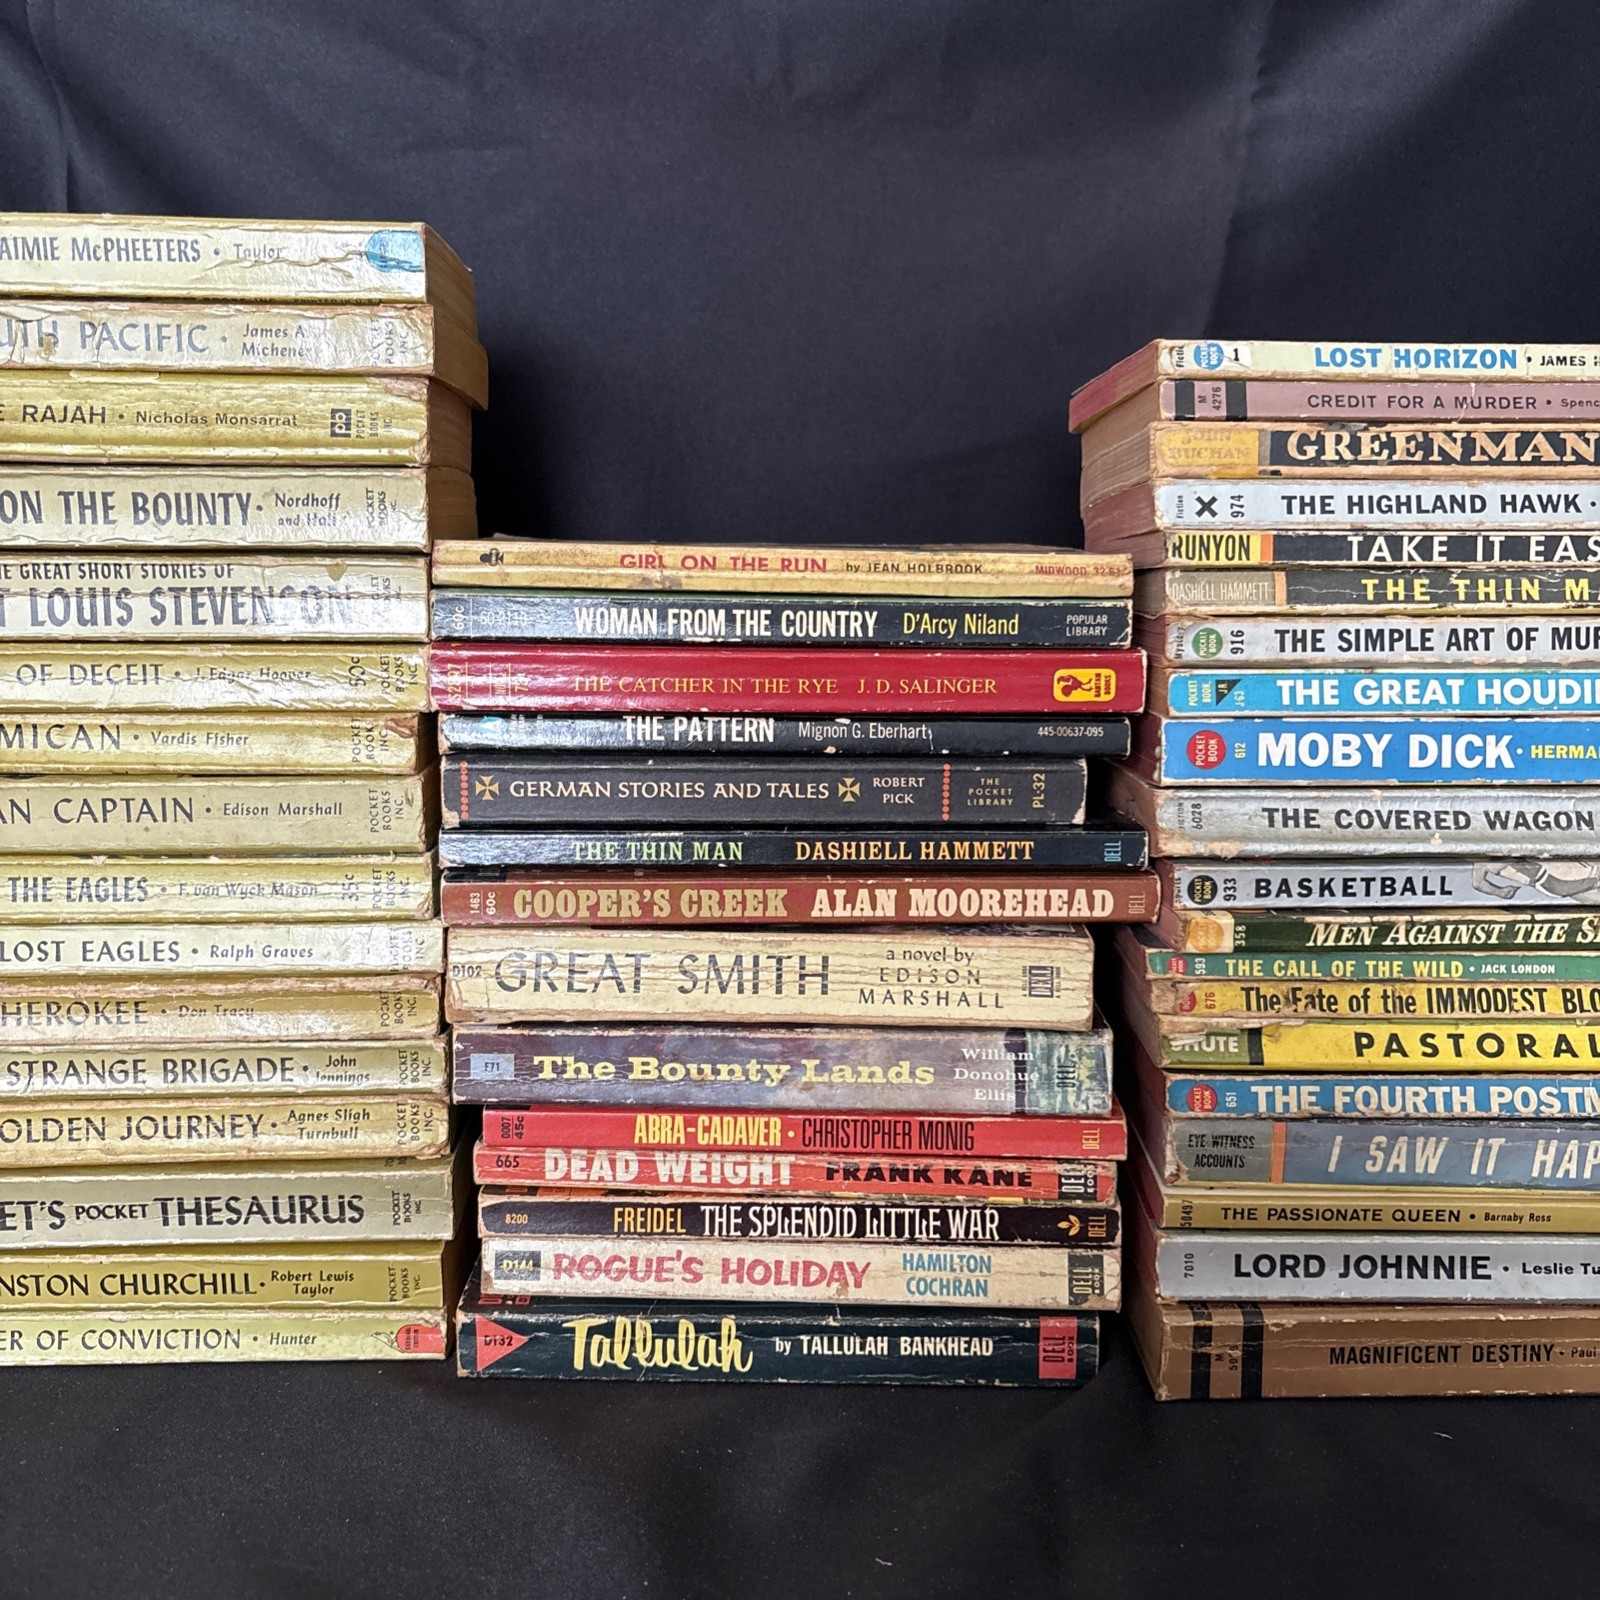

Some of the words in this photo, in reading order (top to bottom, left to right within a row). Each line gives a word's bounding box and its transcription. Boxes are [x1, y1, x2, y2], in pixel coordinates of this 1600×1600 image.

[71, 236, 201, 263] McPHEETERS
[80, 321, 207, 353] PACIFIC
[1315, 347, 1382, 368] LOST
[1394, 349, 1517, 369] HORIZON
[1540, 355, 1586, 367] JAMES
[1308, 394, 1376, 409] CREDIT
[1387, 395, 1423, 409] FOR
[1454, 396, 1537, 410] MURDER
[22, 405, 107, 424] RAJAH
[135, 411, 208, 426] Nicholas
[216, 412, 298, 427] Monsarrat
[58, 491, 116, 525] THE
[133, 492, 251, 526] BOUNTY
[1281, 495, 1335, 515] THE
[1347, 495, 1486, 514] HIGHLAND
[1500, 494, 1581, 513] HAWK
[1347, 536, 1448, 561] TAKE
[1477, 536, 1510, 561] IT
[20, 563, 72, 581] GREAT
[78, 563, 132, 580] SHORT
[619, 554, 667, 569] GIRL
[681, 556, 717, 570] ON
[730, 557, 768, 571] THE
[781, 558, 827, 573] RUN
[846, 562, 860, 574] by
[867, 562, 900, 574] JEAN
[907, 563, 983, 574] HOLBROOK
[1362, 579, 1431, 601] THE
[1455, 579, 1540, 601] THIN
[30, 587, 133, 627] LOUIS
[574, 608, 658, 636] WOMAN
[669, 608, 726, 636] FROM
[733, 609, 771, 637] THE
[782, 610, 878, 638] COUNTRY
[904, 612, 957, 639] D'Arcy
[964, 613, 1019, 635] Niland
[1066, 614, 1108, 626] POPULAR
[1066, 625, 1107, 637] LIBRARY
[1275, 629, 1325, 653] THE
[1337, 628, 1434, 652] SIMPLE
[1446, 628, 1495, 651] ART
[1506, 627, 1539, 651] OF
[70, 664, 164, 686] DECEIT
[618, 678, 714, 693] CATCHER
[722, 679, 744, 693] IN
[751, 679, 790, 693] THE
[798, 679, 838, 694] RYE
[899, 679, 997, 694] SALINGER
[1276, 679, 1340, 706] THE
[1354, 679, 1465, 705] GREAT
[151, 731, 198, 746] Vardis
[206, 731, 249, 746] Fisher
[674, 717, 774, 743] PATTERN
[798, 722, 847, 741] Mignon
[1037, 726, 1104, 737] 445-00637-095
[1258, 732, 1393, 768] MOBY
[1409, 735, 1516, 769] DICK
[510, 781, 611, 798] GERMAN
[618, 782, 705, 798] STORIES
[713, 783, 761, 798] AND
[768, 783, 829, 799] TALES
[873, 777, 925, 788] ROBERT
[969, 788, 1012, 796] POCKET
[981, 778, 999, 786] THE
[883, 793, 914, 804] PICK
[967, 798, 1014, 806] LIBRARY
[54, 797, 194, 823] CAPTAIN
[223, 803, 269, 816] Edison
[278, 802, 342, 816] Marshall
[370, 788, 379, 833] POCKET
[1261, 808, 1320, 829] THE
[1334, 809, 1470, 830] COVERED
[1483, 810, 1594, 830] WAGON
[626, 842, 683, 861] THIN
[693, 842, 743, 861] MAN
[796, 842, 912, 861] DASHIELL
[920, 842, 1035, 861] HAMMETT
[67, 877, 149, 902] EAGLES
[1254, 876, 1453, 898] BASKETBALL
[681, 889, 789, 918] CREEK
[811, 889, 897, 917] ALAN
[909, 889, 1115, 918] MOOREHEAD
[82, 941, 180, 962] EAGLES
[210, 945, 254, 959] Ralph
[263, 946, 314, 958] Graves
[903, 947, 946, 961] novel
[495, 952, 651, 993] GREAT
[677, 954, 829, 995] SMITH
[880, 967, 981, 985] EDISON
[1226, 960, 1263, 976] THE
[1273, 960, 1321, 976] CALL
[1332, 961, 1355, 976] OF
[1365, 961, 1401, 976] THE
[1411, 961, 1463, 977] WILD
[1481, 964, 1507, 974] JACK
[1512, 964, 1554, 974] LONDON
[858, 988, 1004, 1009] MARSHALL
[1426, 989, 1547, 1013] IMMODEST
[6, 1060, 147, 1084] STRANGE
[162, 1057, 294, 1084] BRIGADE
[325, 1055, 356, 1068] John
[533, 1056, 616, 1081] The
[628, 1056, 791, 1087] Bounty
[801, 1059, 935, 1084] Lands
[1251, 1086, 1320, 1112] THE
[1334, 1086, 1475, 1113] FOURTH
[120, 1114, 265, 1140] JOURNEY
[634, 1115, 782, 1146] ABRA-CADAVER
[802, 1118, 912, 1149] CHRISTOPHER
[919, 1120, 974, 1150] MONIG
[495, 1155, 520, 1168] 665
[545, 1148, 639, 1181] DEAD
[655, 1152, 795, 1186] WEIGHT
[1194, 1155, 1245, 1168] ACCOUNTS
[1366, 1137, 1448, 1174] SAW
[1471, 1139, 1506, 1176] IT
[75, 1204, 148, 1220] POCKET
[152, 1195, 365, 1227] THESAURUS
[505, 1213, 528, 1224] 8200
[1221, 1207, 1258, 1221] THE
[1267, 1207, 1383, 1222] PASSIONATE
[1391, 1208, 1460, 1223] QUEEN
[1484, 1212, 1524, 1225] Barnaby
[1529, 1212, 1551, 1223] Ross
[613, 1207, 686, 1233] FREIDEL
[700, 1206, 743, 1237] THE
[748, 1206, 857, 1237] SPLENDID
[864, 1207, 941, 1239] LITTLE
[948, 1208, 999, 1240] WAR
[553, 1250, 704, 1284] ROGUE'S
[721, 1257, 871, 1289] HOLIDAY
[902, 1253, 991, 1274] HAMILTON
[1184, 1253, 1194, 1278] 7010
[1234, 1254, 1325, 1278] LORD
[1338, 1255, 1492, 1280] JOHNNIE
[1522, 1262, 1574, 1275] Leslie
[100, 1273, 257, 1296] CHURCHILL
[271, 1270, 312, 1283] Robert
[320, 1270, 354, 1283] Lewis
[906, 1276, 988, 1297] COCHRAN
[294, 1283, 334, 1297] Taylor
[37, 1330, 69, 1351] OF
[81, 1328, 241, 1350] CONVICTION
[270, 1332, 318, 1345] Hunter
[484, 1334, 513, 1346] D132
[562, 1316, 753, 1372] Tallulah
[800, 1335, 888, 1355] TALLULAH
[900, 1336, 993, 1356] BANKHEAD
[1329, 1345, 1461, 1365] MAGNIFICENT
[1472, 1344, 1555, 1363] DESTINY
